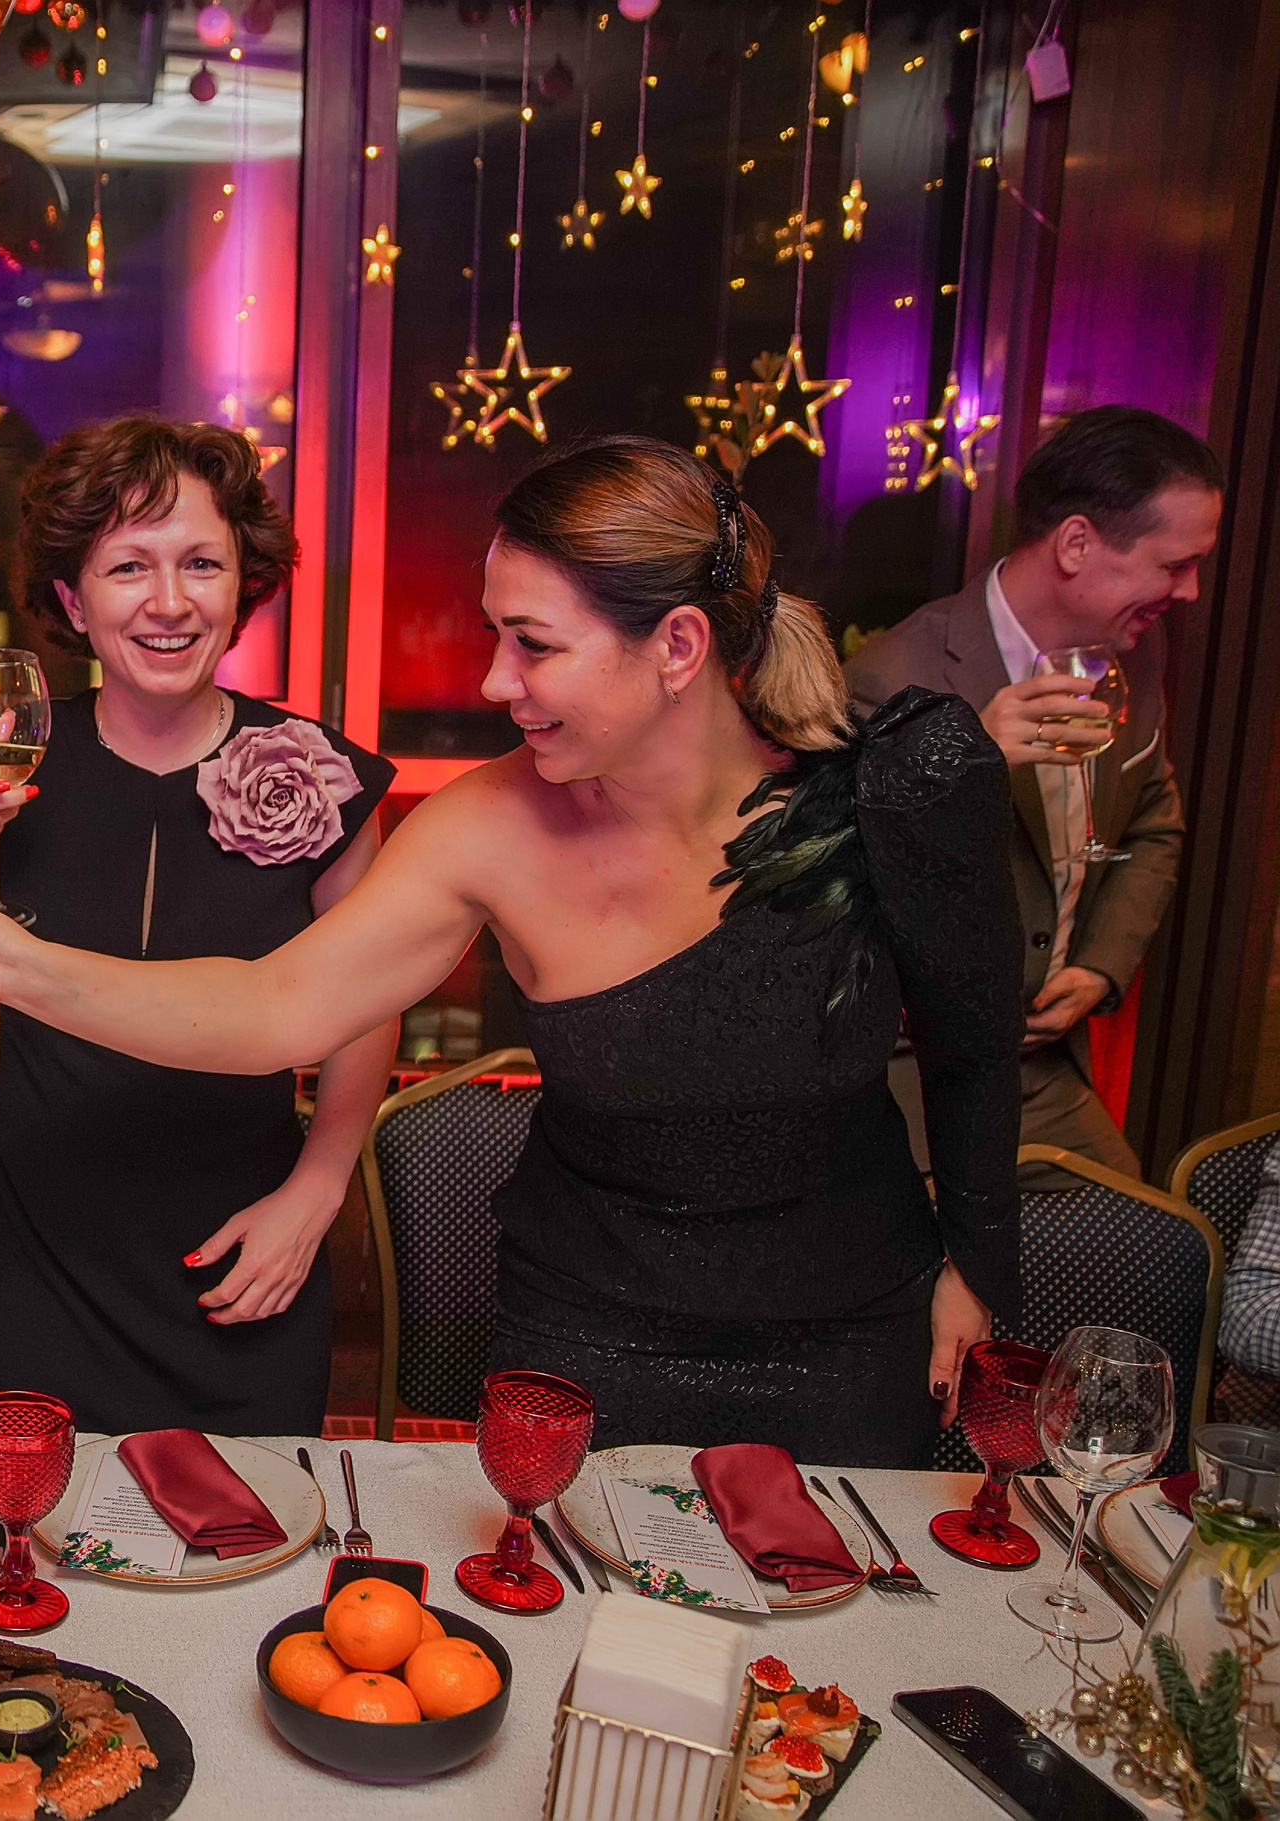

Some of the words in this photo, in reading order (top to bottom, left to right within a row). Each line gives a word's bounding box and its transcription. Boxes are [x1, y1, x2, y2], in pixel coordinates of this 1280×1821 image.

[133, 1530, 171, 1538] ГОРЯЧЕЕ
[644, 1554, 676, 1562] ВЫБОР
[693, 1561, 734, 1571] ГОРЯЧЕЕ
